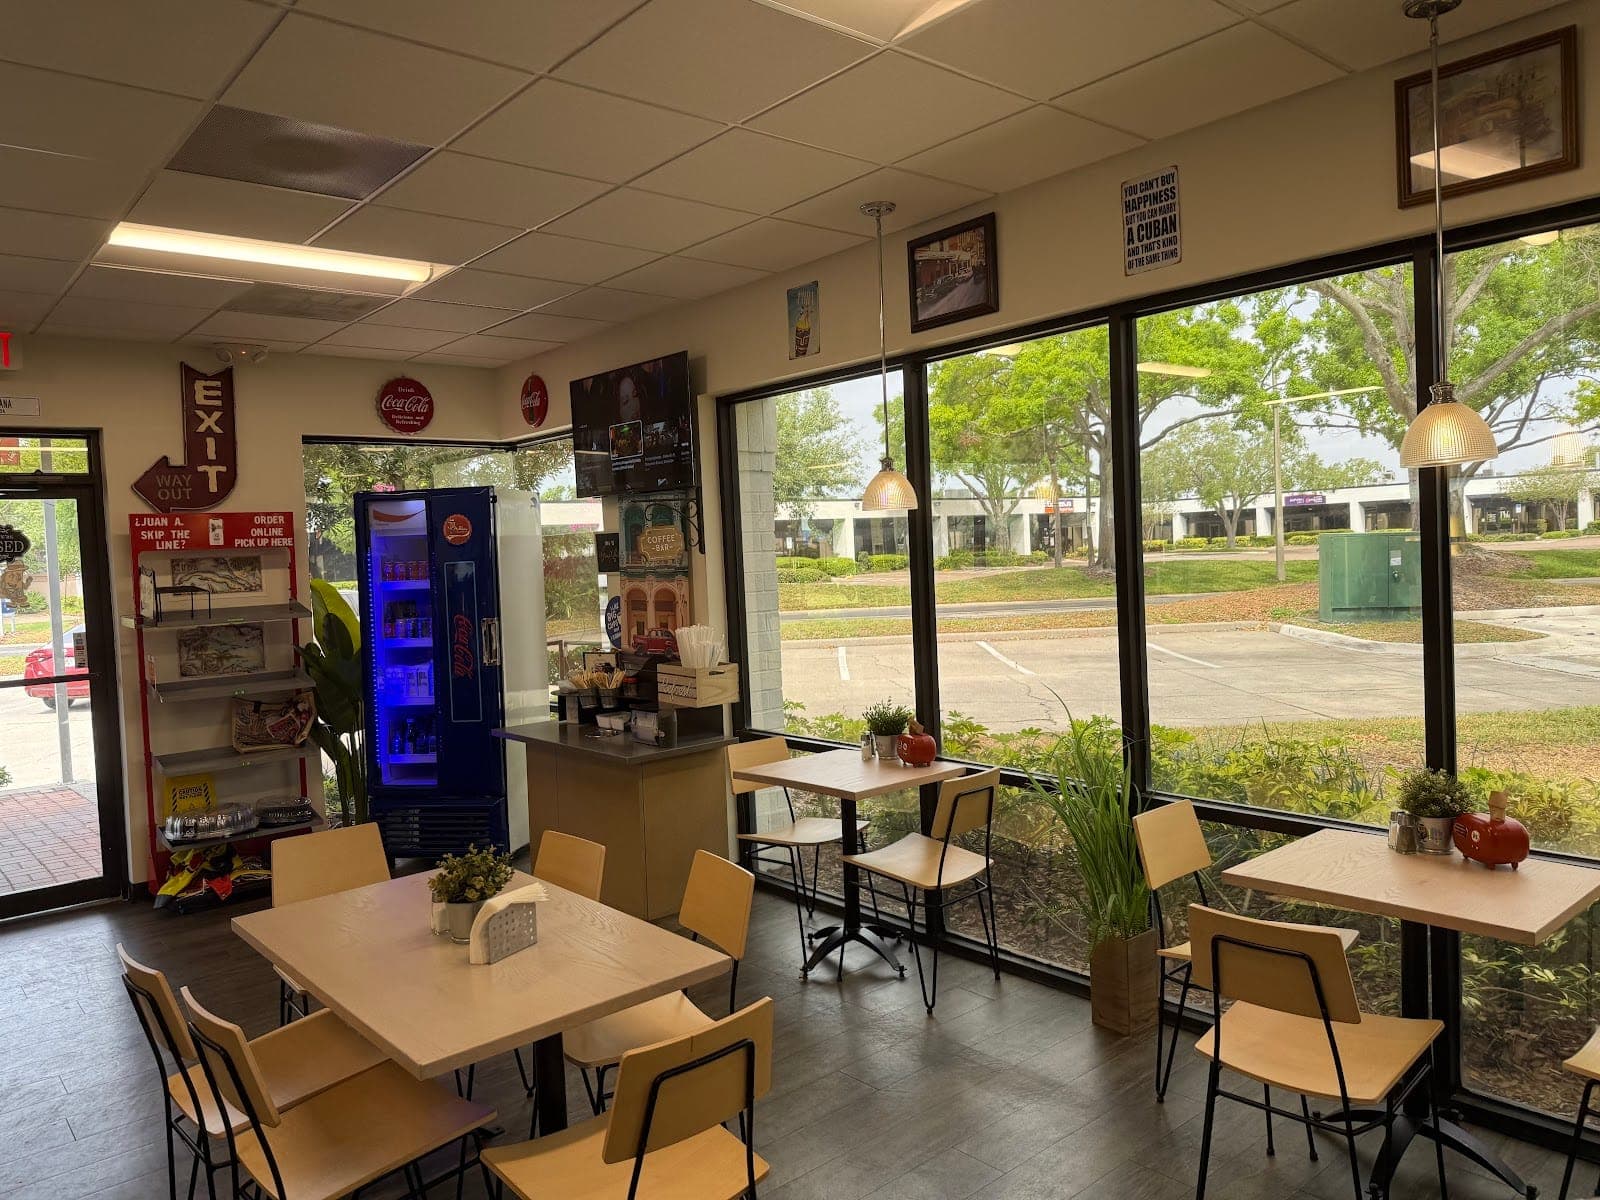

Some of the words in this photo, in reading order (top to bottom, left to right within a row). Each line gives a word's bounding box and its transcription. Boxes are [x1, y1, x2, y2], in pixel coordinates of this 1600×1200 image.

[1125, 183, 1138, 199] YOU
[1140, 177, 1160, 194] CAN'T
[1161, 172, 1175, 187] BUY
[1125, 186, 1176, 214] HAPPINESS
[1125, 214, 1136, 226] BUT
[1136, 211, 1147, 223] YOU
[1147, 208, 1158, 220] CAN
[1158, 202, 1176, 216] MARRY
[1127, 226, 1135, 246] A
[1137, 213, 1177, 243] CUBAN
[1127, 245, 1140, 258] AND
[1141, 240, 1161, 255] THAT'S
[1162, 235, 1178, 249] KIND
[1127, 259, 1134, 270] OF
[1135, 256, 1145, 268] THE
[1145, 253, 1161, 265] SAME
[1161, 248, 1178, 261] THING
[381, 394, 431, 413] Coca-Cola
[193, 379, 227, 493] EXIT
[155, 474, 193, 489] WAY
[157, 488, 193, 501] OUT
[135, 516, 169, 527] ¿JUAN
[254, 515, 285, 525] ORDER
[140, 530, 165, 540] SKIP
[171, 530, 191, 539] THE
[250, 527, 284, 537] ONLINE
[647, 534, 676, 544] COFFEE
[155, 539, 186, 550] LINE?
[234, 537, 256, 548] PICK
[257, 537, 269, 547] UP
[271, 536, 294, 547] HERE
